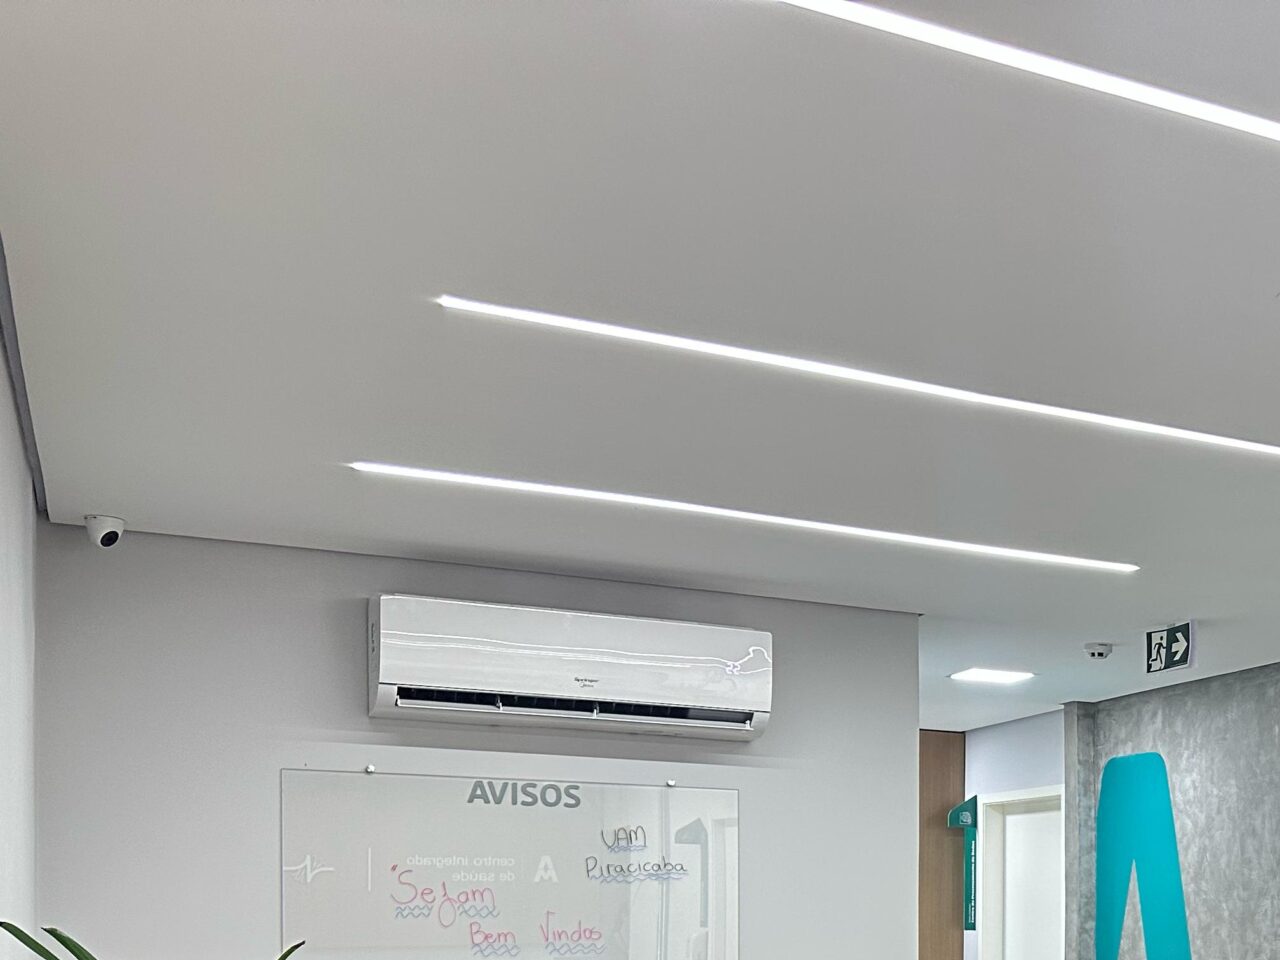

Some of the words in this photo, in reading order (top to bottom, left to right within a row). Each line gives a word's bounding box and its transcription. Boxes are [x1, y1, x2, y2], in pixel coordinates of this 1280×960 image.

[467, 780, 581, 808] AVISOS
[601, 825, 647, 848] UAM
[585, 855, 687, 878] Piracicaba
[470, 921, 516, 945] Bem
[540, 911, 602, 943] Vindos
